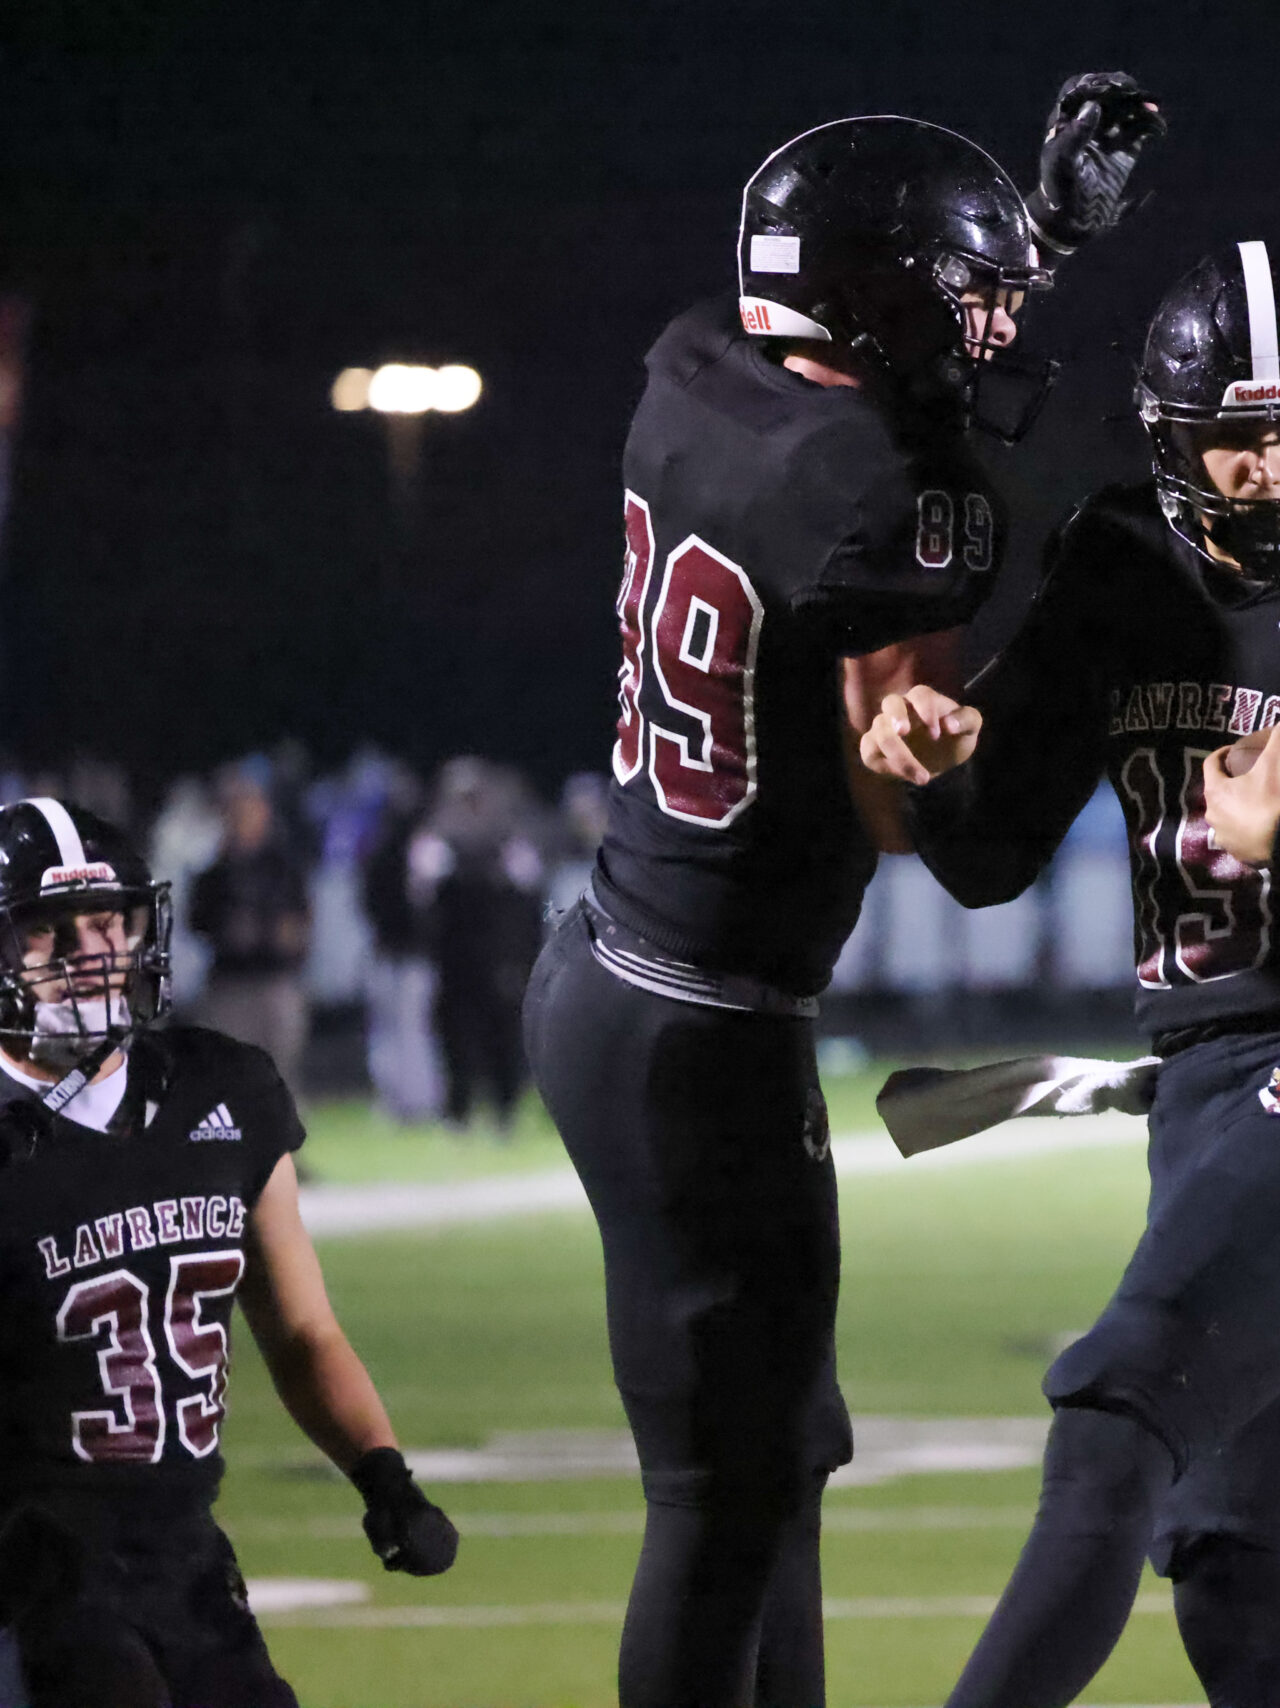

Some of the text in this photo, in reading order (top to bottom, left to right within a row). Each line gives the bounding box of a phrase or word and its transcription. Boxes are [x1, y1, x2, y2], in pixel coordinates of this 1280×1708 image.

[916, 490, 993, 571] 89
[1121, 747, 1273, 990] 15
[189, 1127, 242, 1142] adidas
[38, 1195, 247, 1279] LAWRENCE
[56, 1249, 246, 1464] 35
